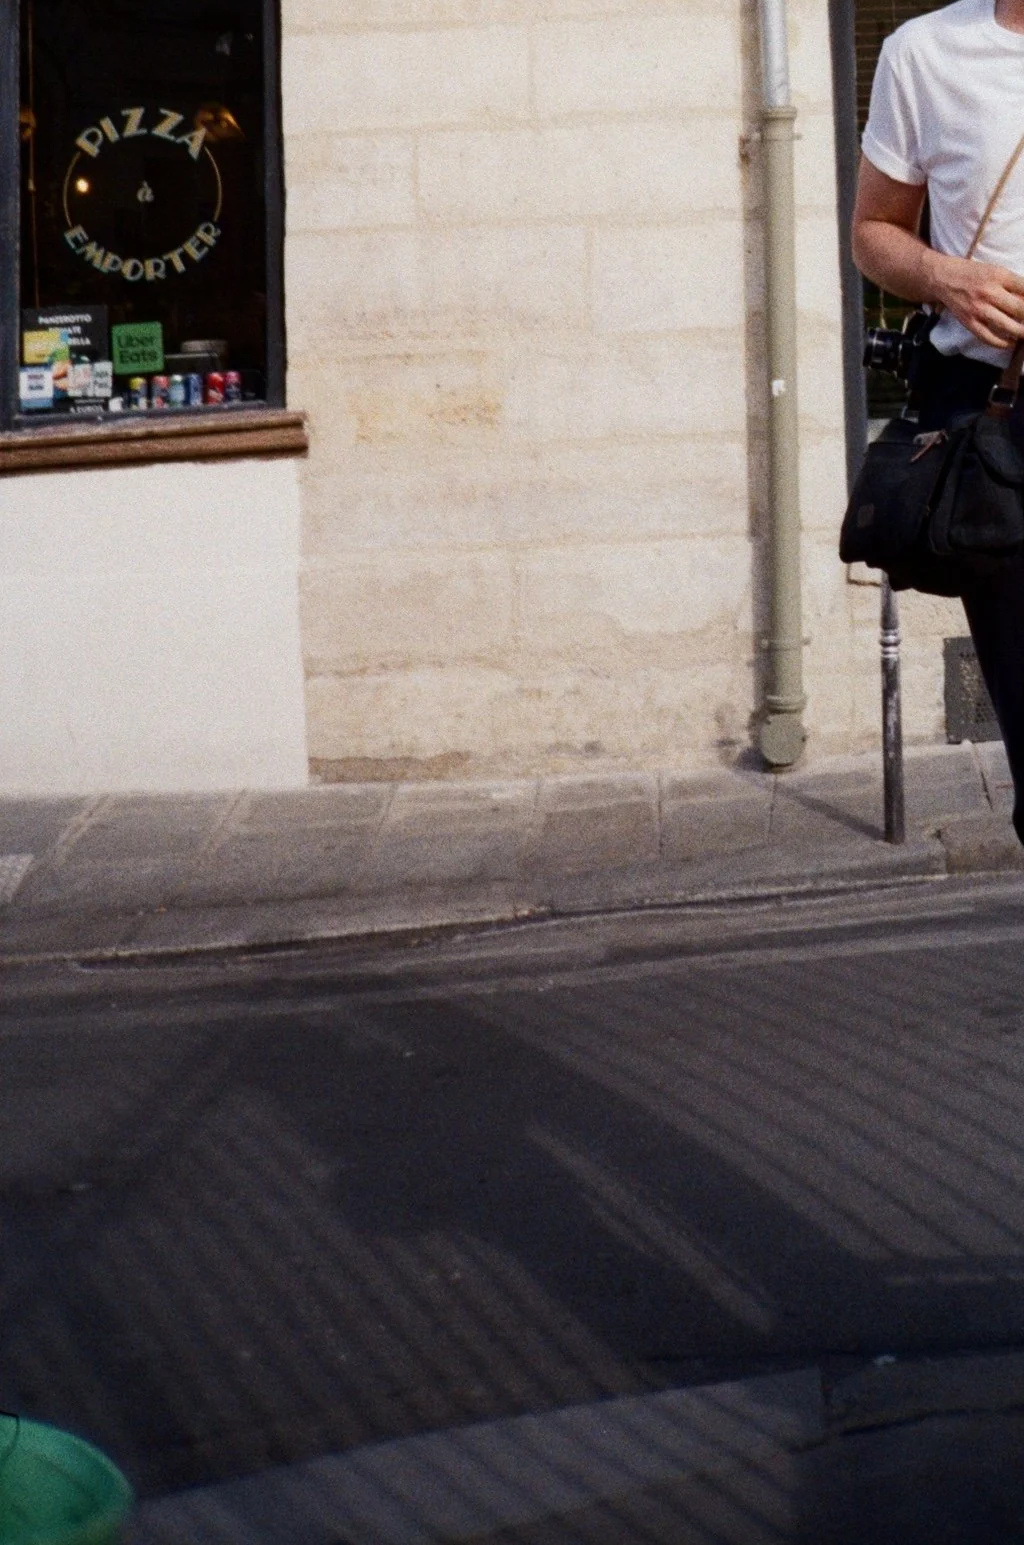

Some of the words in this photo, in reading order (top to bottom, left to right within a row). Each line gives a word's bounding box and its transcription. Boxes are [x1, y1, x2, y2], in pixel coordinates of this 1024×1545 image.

[75, 107, 207, 160] PIZZA
[64, 223, 221, 281] EMPORTER
[117, 335, 154, 348] Uber
[120, 350, 158, 364] Eats
